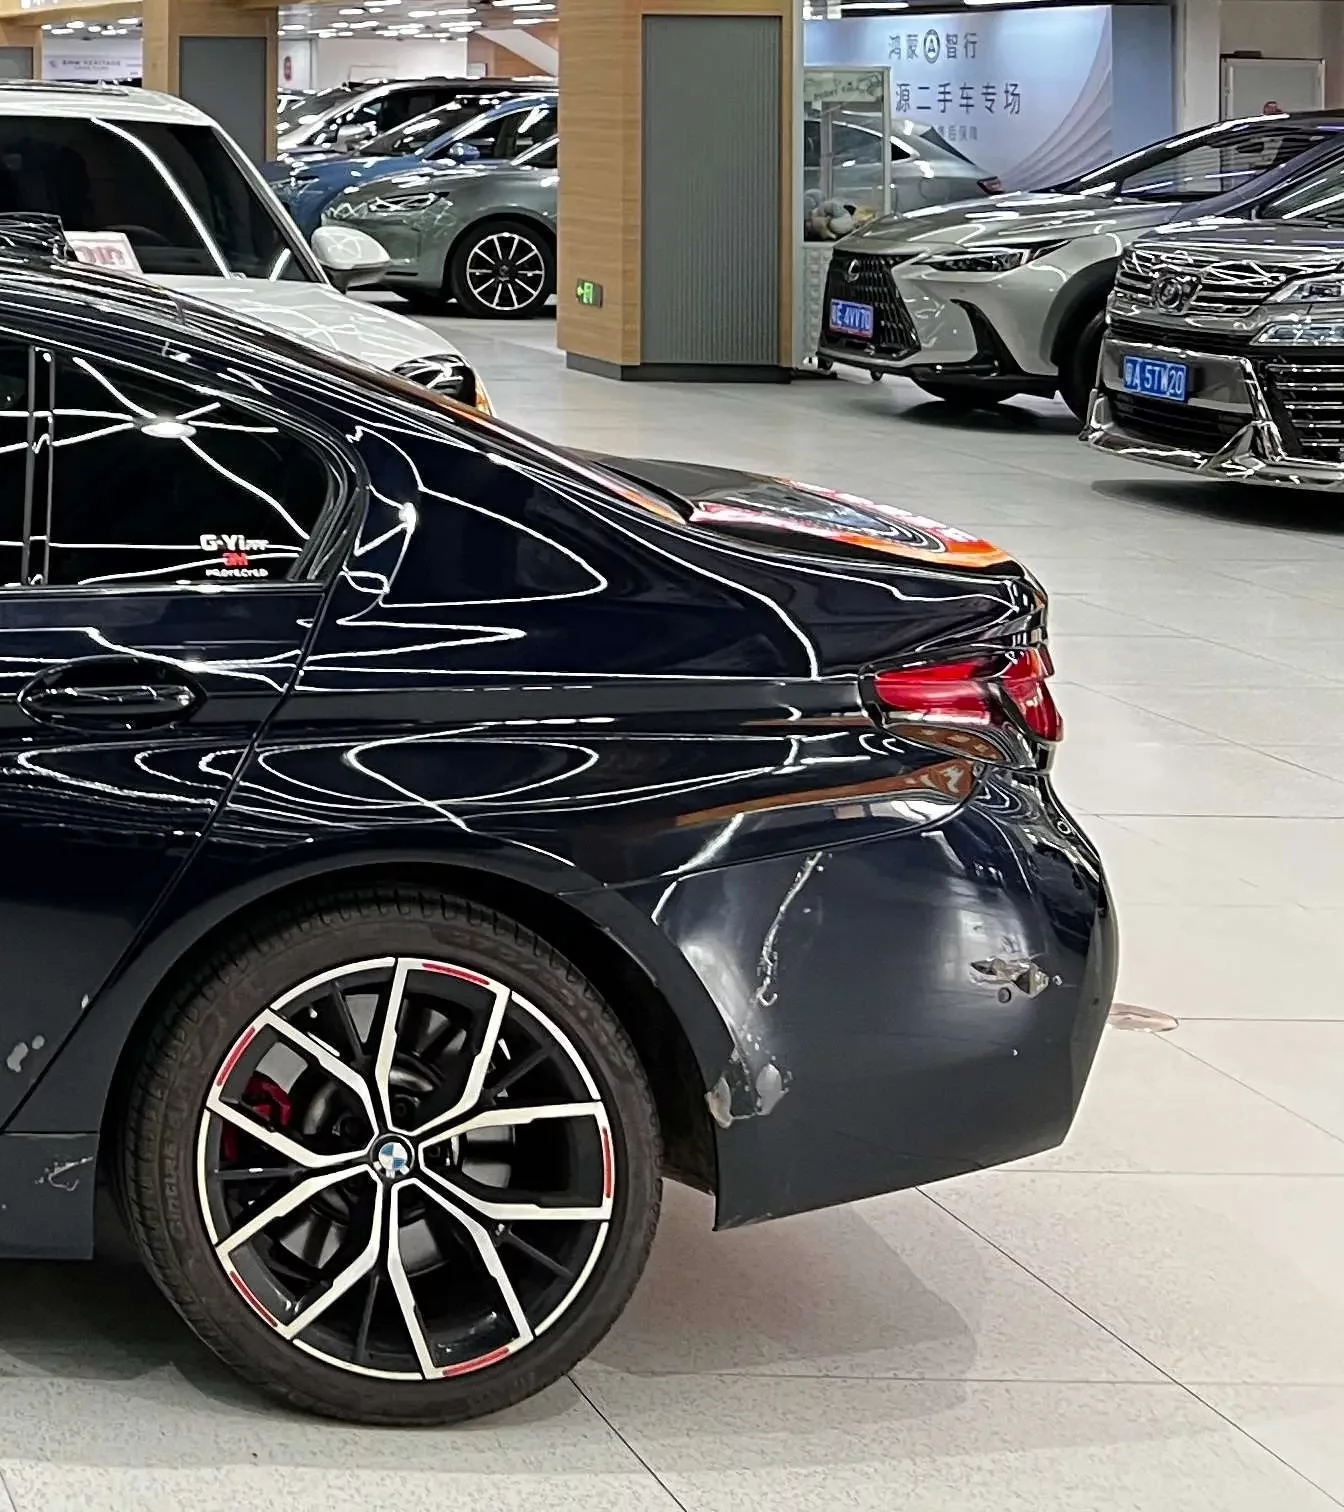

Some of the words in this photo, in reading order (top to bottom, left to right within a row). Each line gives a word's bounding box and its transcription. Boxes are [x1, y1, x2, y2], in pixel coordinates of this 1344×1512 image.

[896, 82, 1021, 115] 源二手车专场
